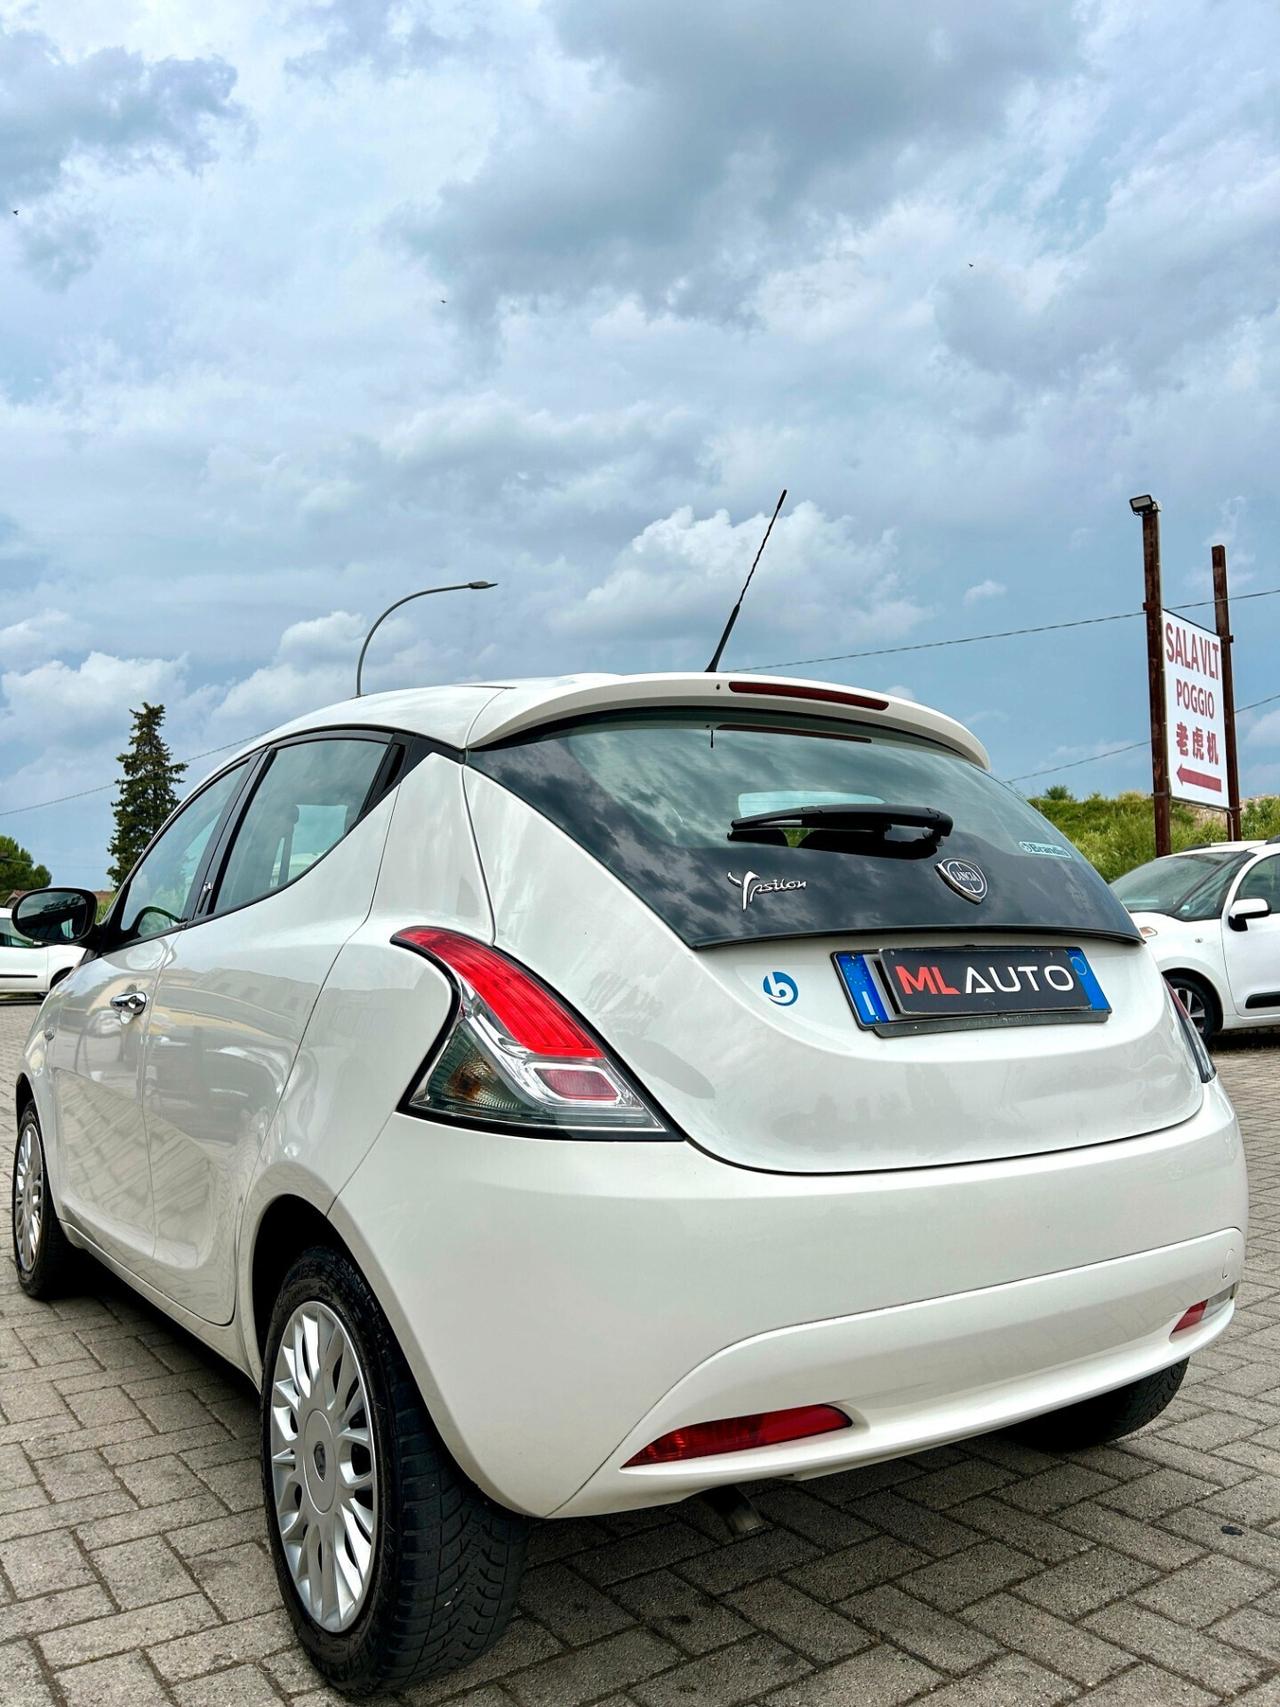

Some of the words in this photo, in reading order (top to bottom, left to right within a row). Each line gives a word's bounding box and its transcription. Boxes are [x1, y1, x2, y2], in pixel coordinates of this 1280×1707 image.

[1165, 622, 1199, 670] SALA
[1199, 637, 1219, 680] VLT
[1176, 678, 1214, 719] POGGIO
[1176, 722, 1219, 765] 老虎机
[727, 871, 807, 911] Ypsilon
[951, 871, 981, 882] LANCIA
[895, 965, 961, 995] ML
[965, 965, 1074, 994] AUTO
